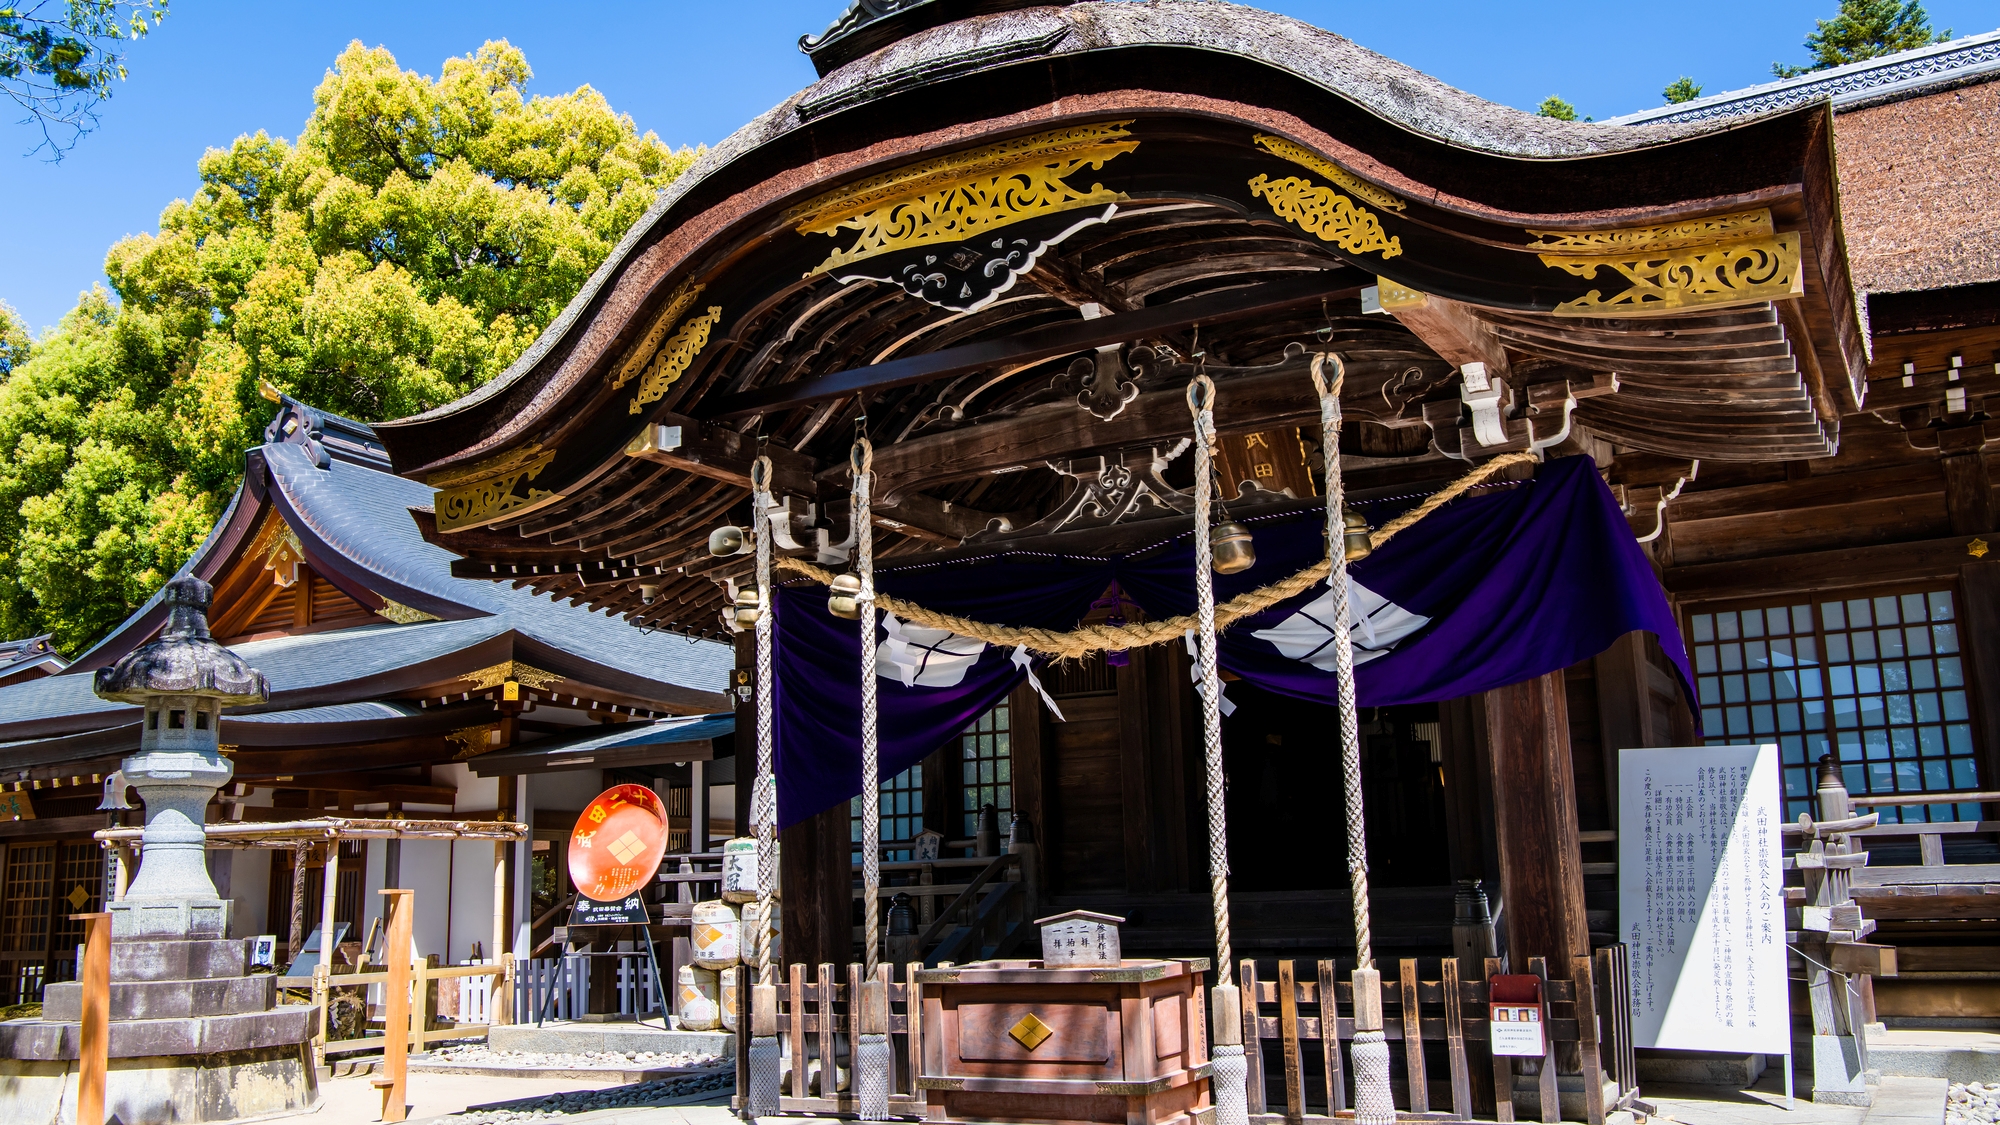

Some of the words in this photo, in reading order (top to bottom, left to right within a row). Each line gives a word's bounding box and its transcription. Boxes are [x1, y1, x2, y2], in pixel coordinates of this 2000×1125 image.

[1698, 767, 1707, 843] 会員は左のとおりです。
[577, 900, 591, 912] 奉
[624, 897, 639, 910] 納
[1757, 806, 1773, 944] 武田神社崇敬会入会のご案内
[1066, 926, 1076, 958] 二拍手
[1631, 922, 1641, 1017] 武田神社崇敬会事務局
